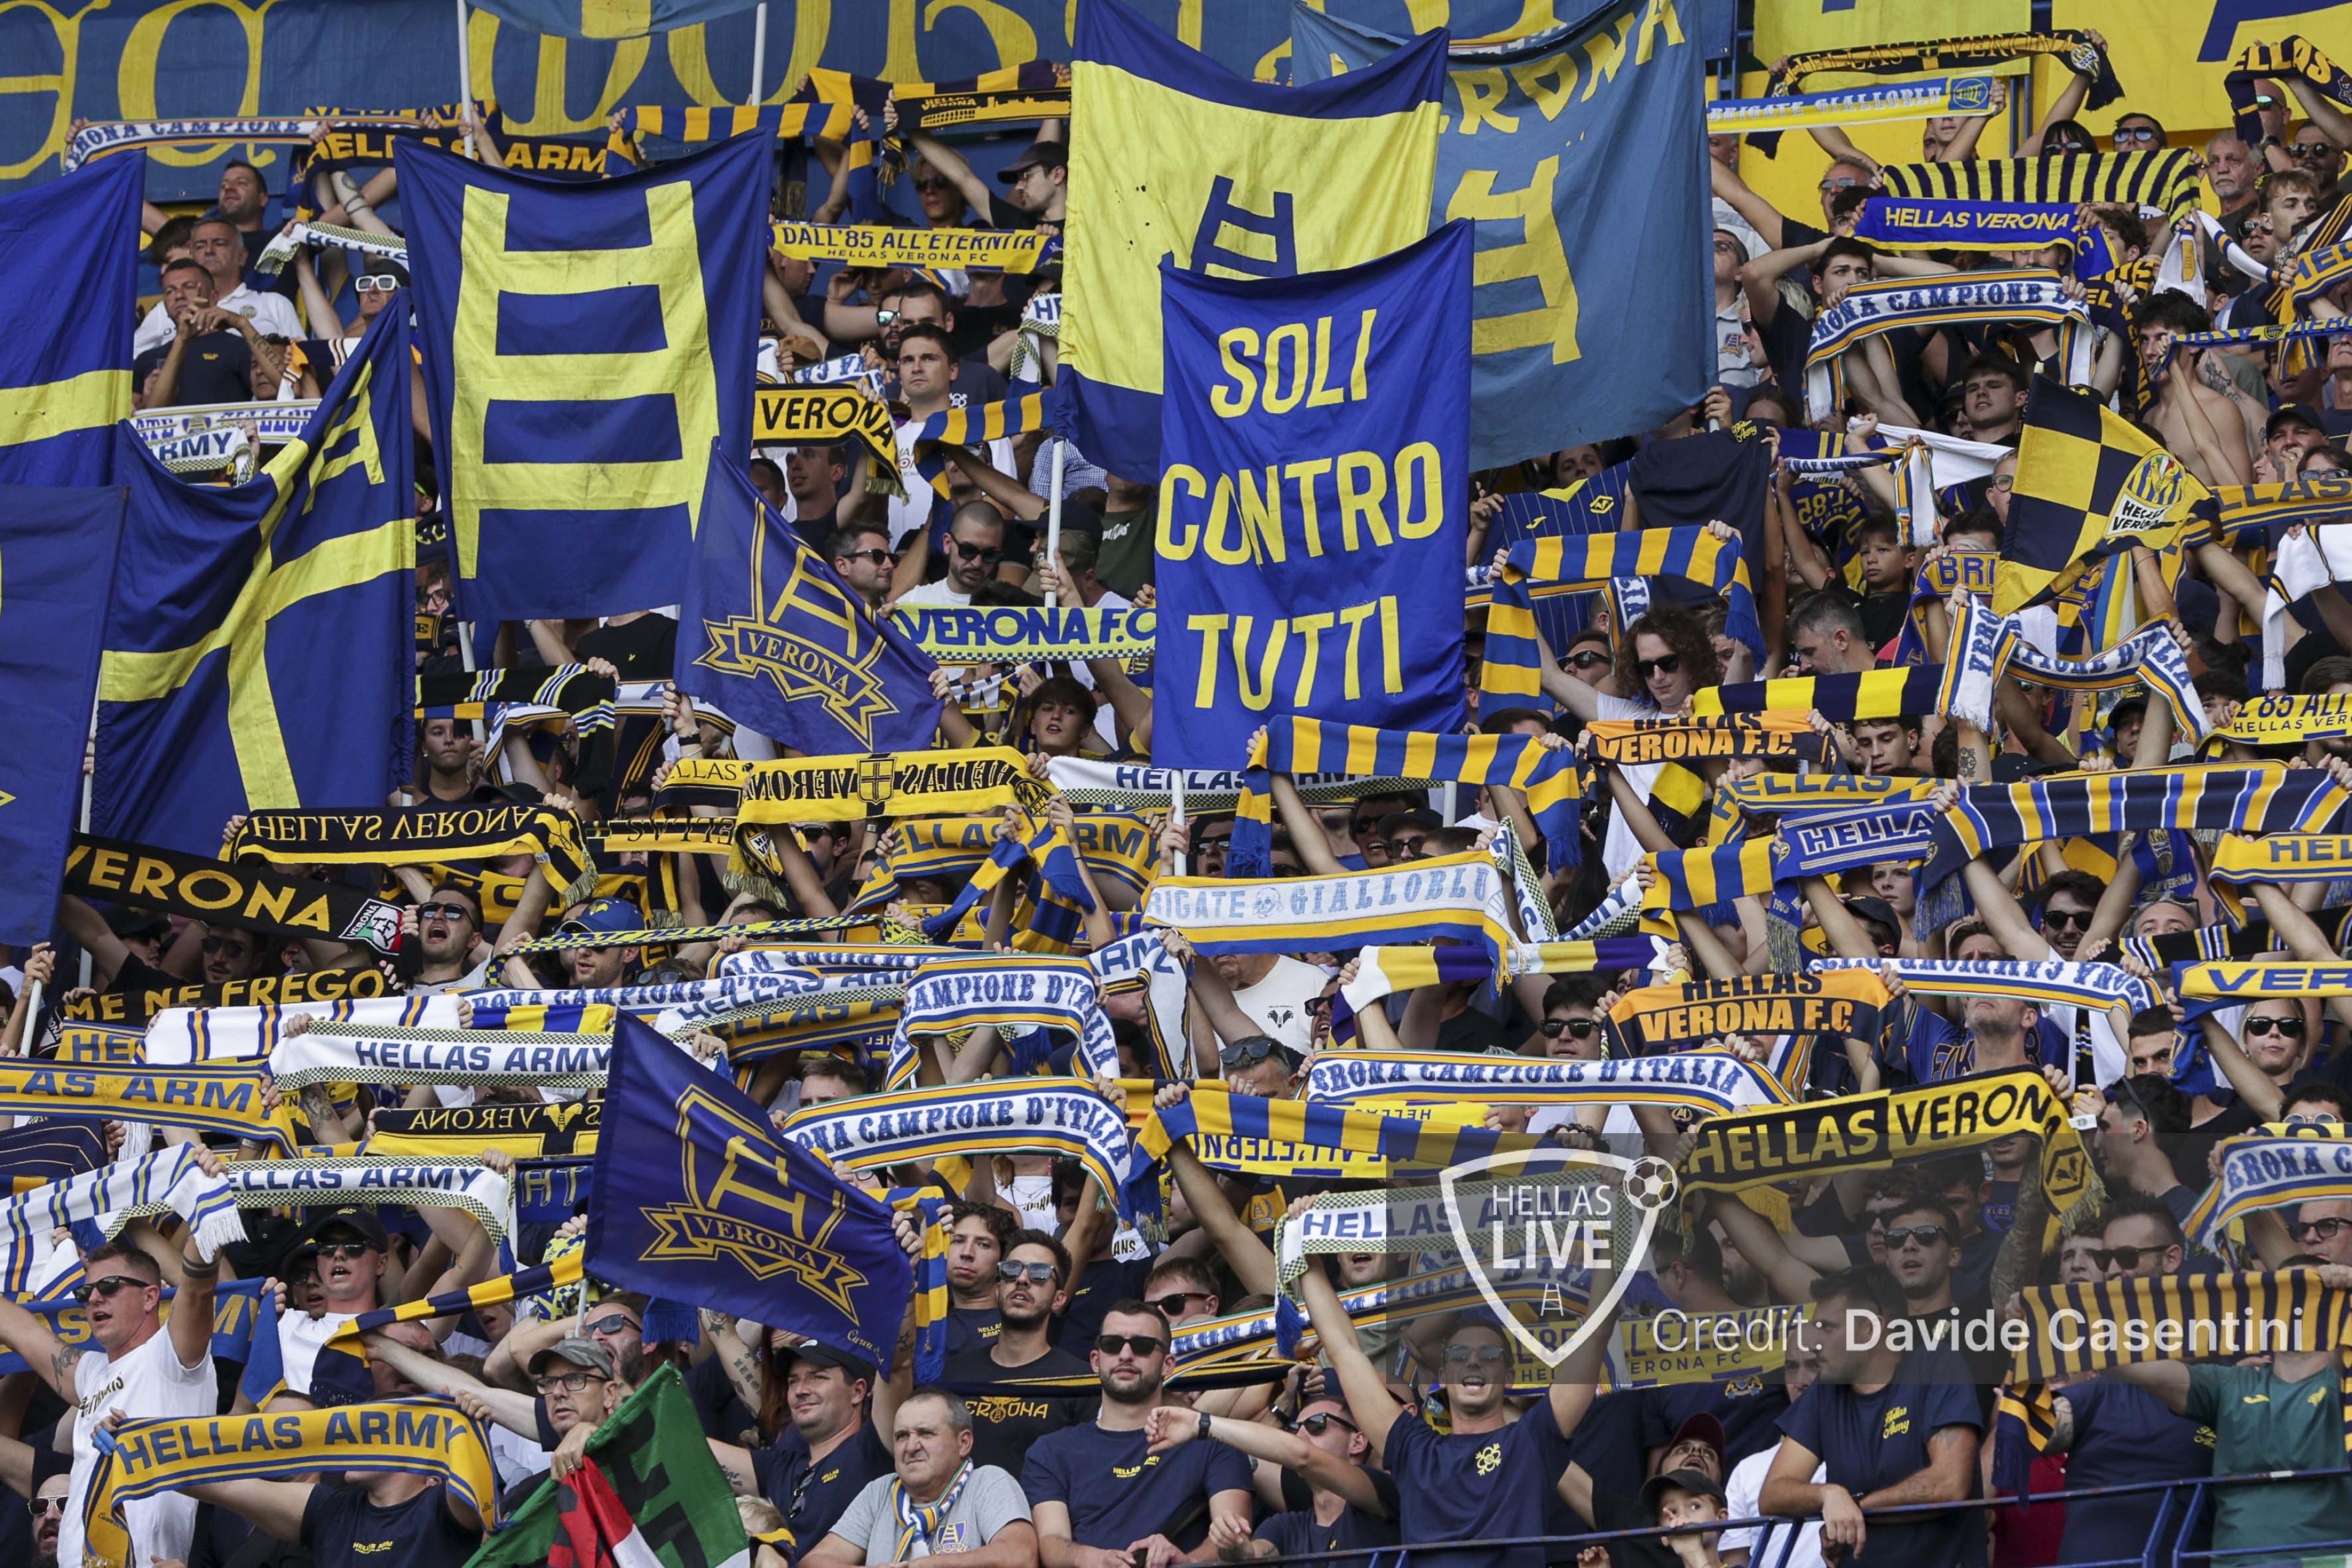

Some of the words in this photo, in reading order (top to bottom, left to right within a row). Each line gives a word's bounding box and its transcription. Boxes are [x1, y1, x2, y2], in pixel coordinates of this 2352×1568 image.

[1814, 86, 1942, 115] GIALLOBLU
[783, 225, 874, 248] DALL'85
[1886, 206, 1973, 228] HELLAS
[1977, 211, 2070, 232] VERONA
[827, 247, 887, 260] HELLAS
[895, 251, 959, 262] VERONA
[970, 252, 989, 262] FC
[1886, 285, 2057, 311] CAMPIONE
[1210, 309, 1378, 419] SOLI
[762, 397, 896, 448] VERONA
[1155, 441, 1444, 570] CONTRO
[748, 633, 850, 695] VERONA
[1186, 595, 1403, 712] TUTTI
[1596, 730, 1736, 764] VERONA
[1742, 729, 1798, 756] F.C.
[2233, 718, 2303, 733] HELLAS
[1074, 823, 1161, 870] RMY
[1290, 867, 1490, 915] GIALLOBLU
[347, 903, 381, 937] VERONA
[62, 992, 126, 1021] ME
[221, 968, 385, 1008] FREGO
[677, 978, 826, 1020] HELLAS
[1682, 972, 1822, 1001] HELLAS
[1638, 999, 1794, 1041] VERONA
[1814, 997, 1853, 1033] F.C.
[356, 1041, 490, 1072] HELLAS
[1420, 1061, 1585, 1084] CAMPIONE
[1599, 1057, 1744, 1096] D'ITALIA
[857, 1099, 1013, 1143] CAMPIONE
[1689, 1110, 1880, 1175] HELLAS
[1896, 1084, 2052, 1147] VERON
[369, 1166, 485, 1193] ARMY
[693, 1215, 816, 1267] VERONA
[1716, 1351, 1743, 1366] FC
[117, 1415, 303, 1475] HELLAS
[325, 1411, 467, 1454] ARMY
